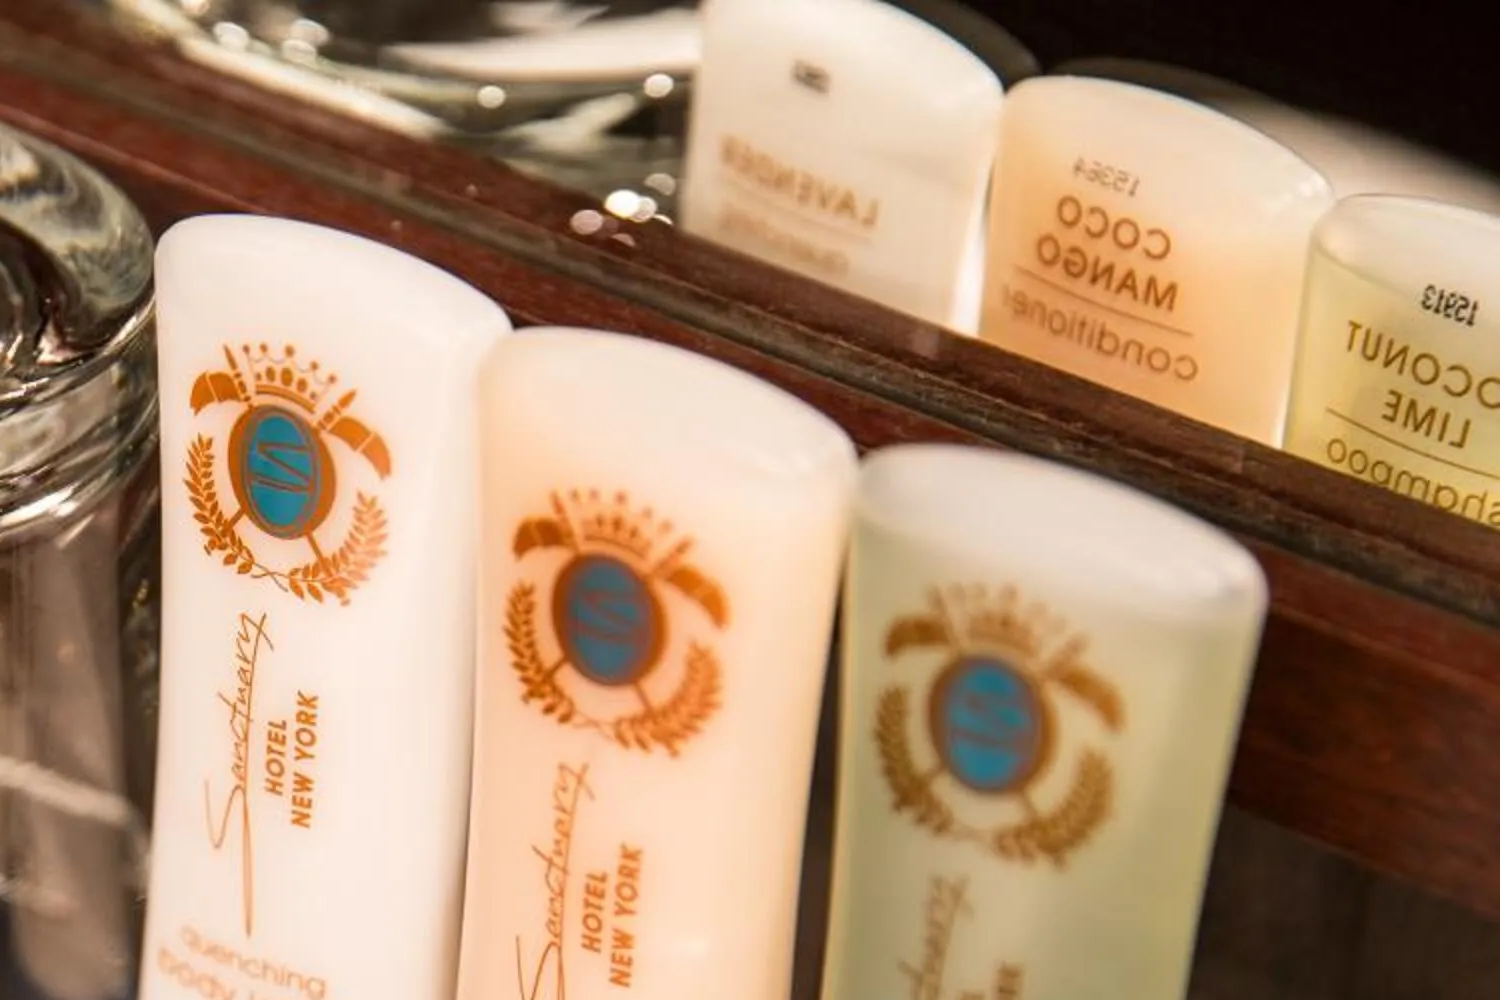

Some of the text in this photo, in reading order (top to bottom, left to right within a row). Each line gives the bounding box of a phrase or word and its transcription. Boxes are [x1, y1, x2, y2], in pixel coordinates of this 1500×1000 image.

[203, 612, 274, 939] Sanctuary
[264, 718, 287, 797] HOTEL
[291, 690, 319, 829] NEW YORK
[581, 871, 609, 954] HOTEL
[608, 841, 643, 989] NEW YORK
